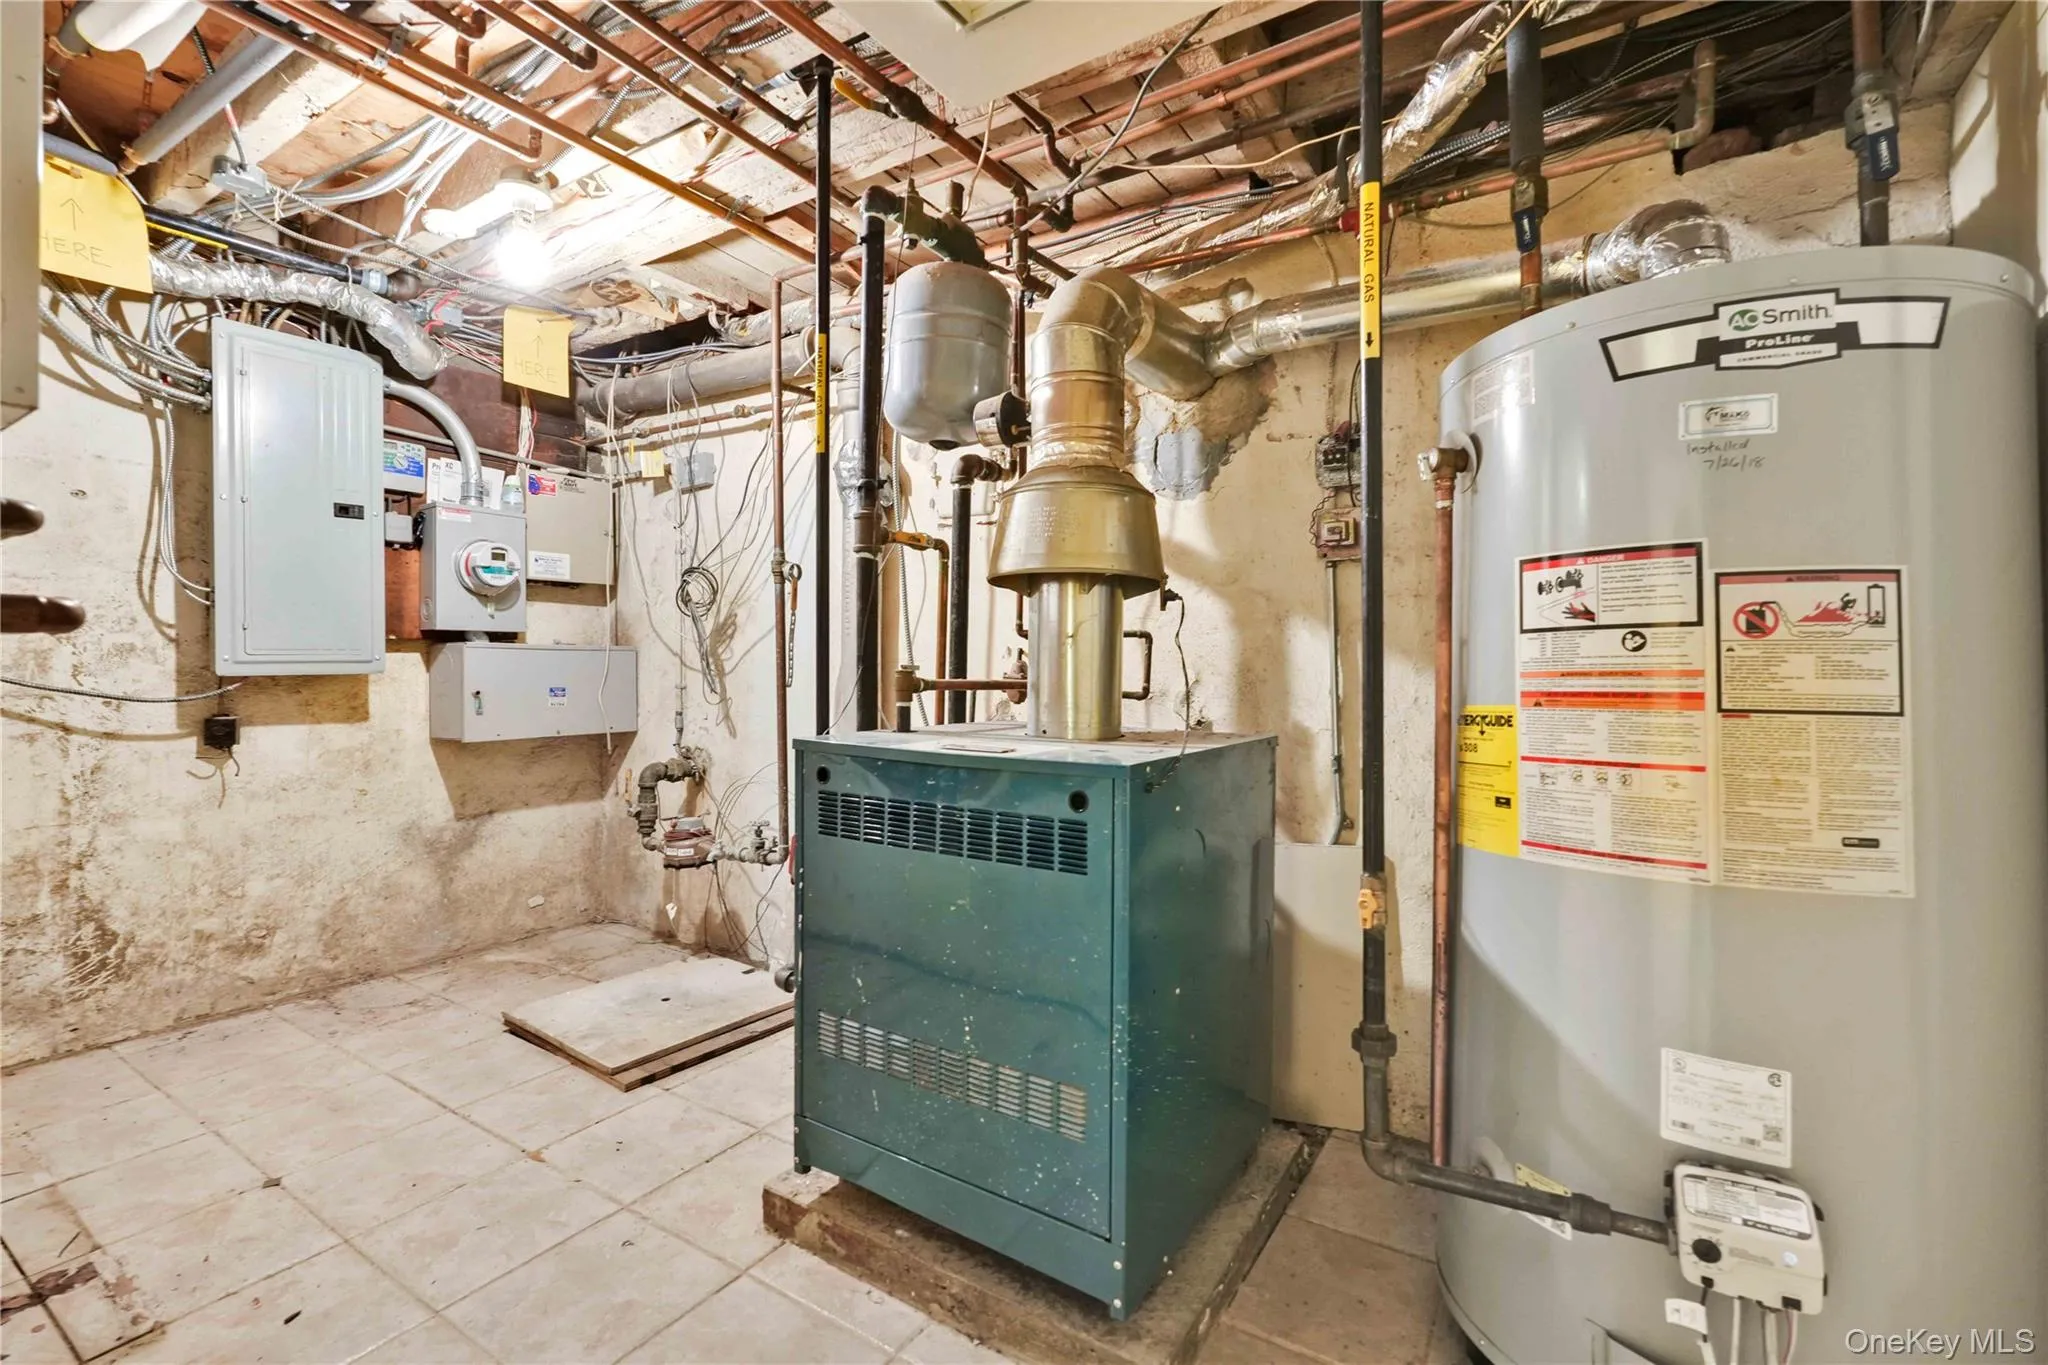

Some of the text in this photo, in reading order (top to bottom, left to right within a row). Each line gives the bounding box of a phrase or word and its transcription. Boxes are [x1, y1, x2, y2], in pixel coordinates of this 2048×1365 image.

[1363, 201, 1375, 303] NATURAL GAS
[1745, 334, 1815, 349] ProLine
[514, 352, 558, 384] HERE
[1686, 438, 1750, 455] Installed
[1703, 455, 1766, 472] 7/26/18
